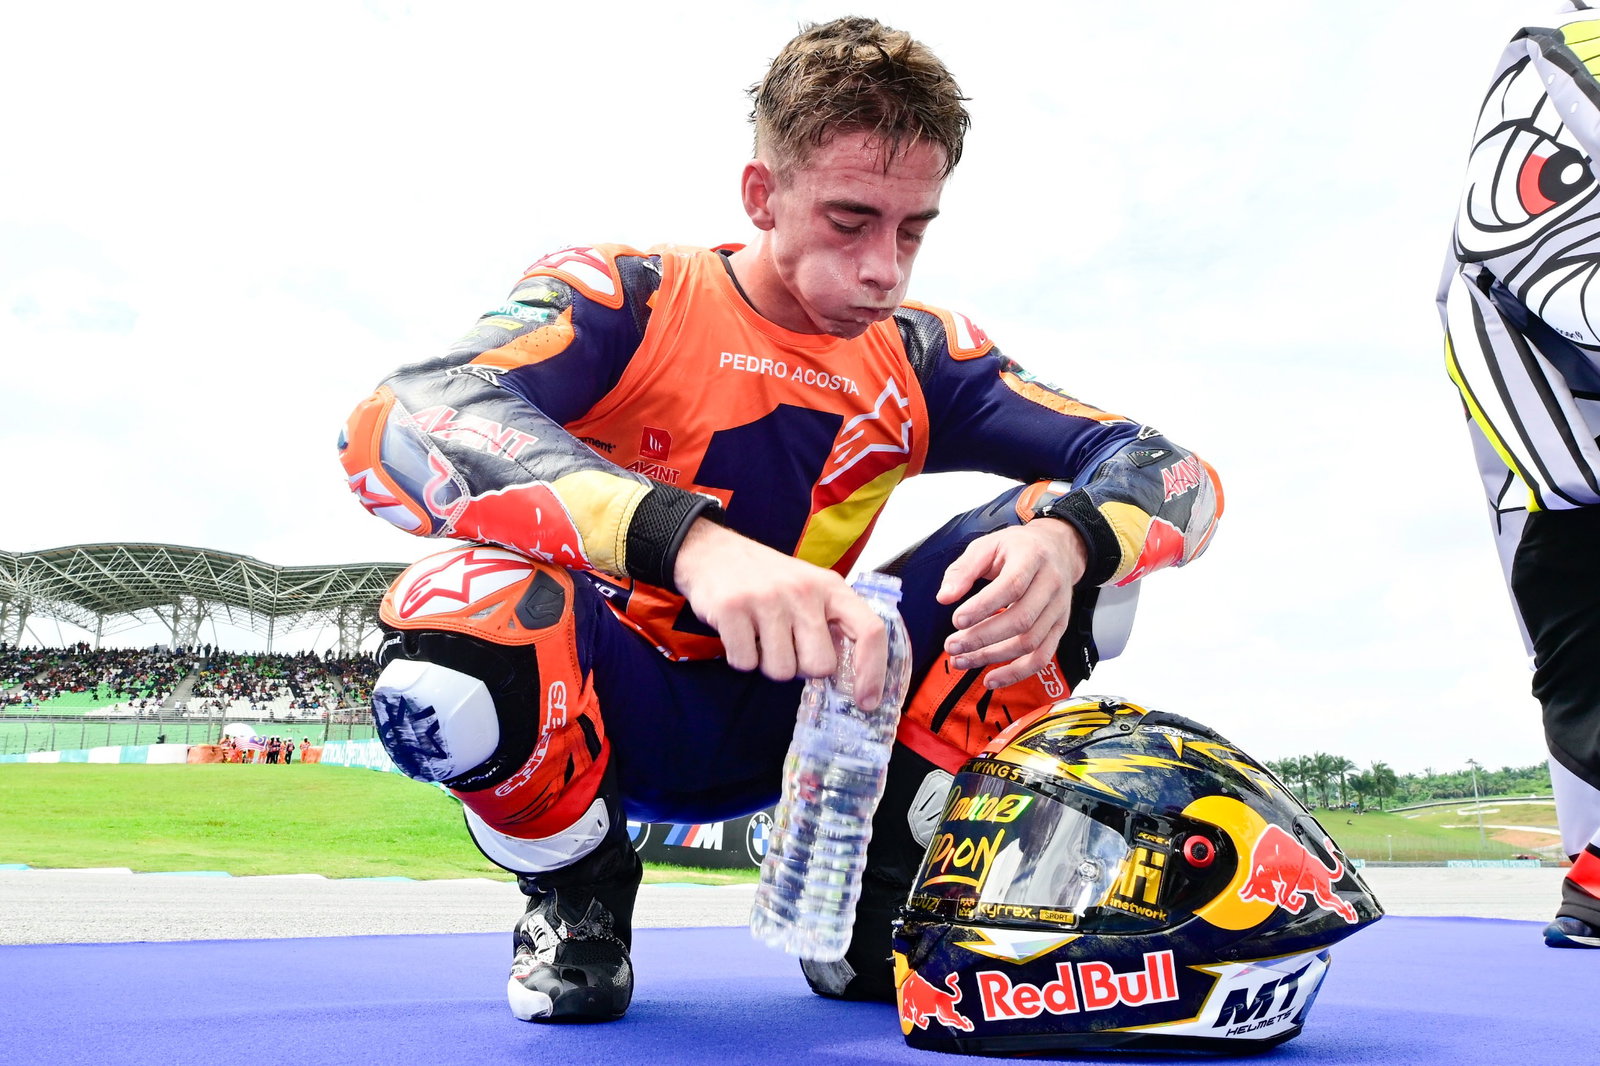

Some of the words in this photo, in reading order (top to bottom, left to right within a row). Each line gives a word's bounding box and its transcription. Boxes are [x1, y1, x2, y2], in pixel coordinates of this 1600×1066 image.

[719, 352, 788, 379] PEDRO
[791, 366, 860, 396] ACOSTA
[403, 405, 539, 462] AVANT
[624, 460, 680, 484] AVANT
[1161, 455, 1201, 503] AVAN
[494, 680, 567, 797] alpinetars
[972, 761, 1023, 781] WINGS
[1044, 911, 1069, 921] SPORT
[977, 962, 1079, 1021] Red
[1077, 950, 1179, 1011] Bull
[1212, 960, 1313, 1028] MT
[1226, 1006, 1297, 1037] HELMETS
